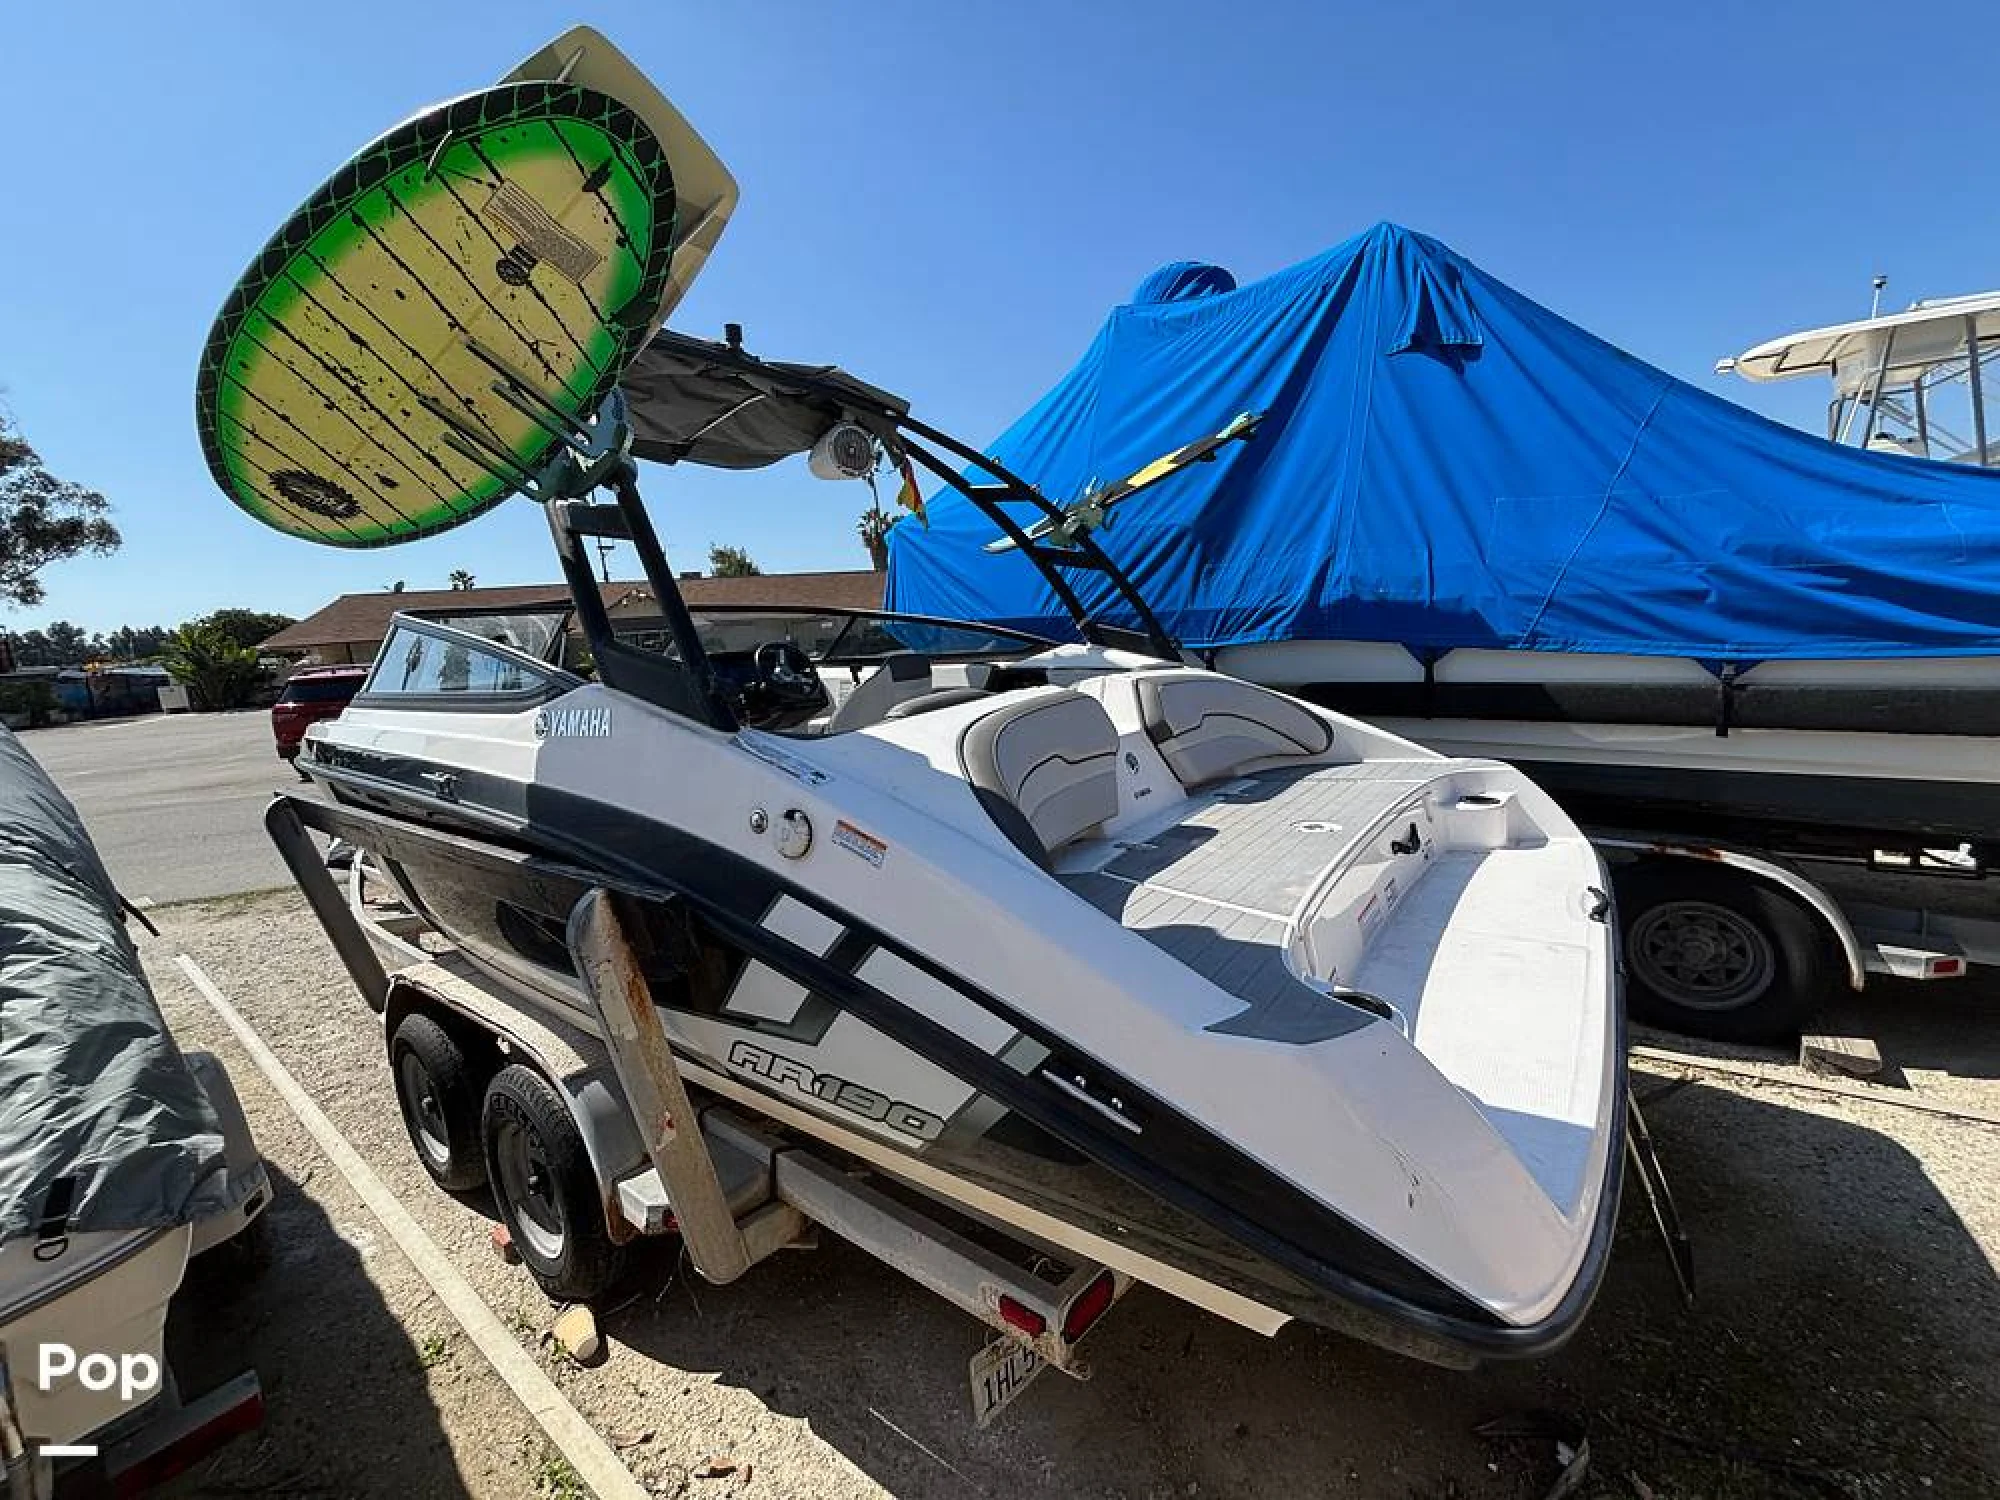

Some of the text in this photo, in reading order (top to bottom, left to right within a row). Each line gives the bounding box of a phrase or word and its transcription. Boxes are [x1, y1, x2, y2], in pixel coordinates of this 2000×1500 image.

[550, 709, 611, 737] YAMAHA
[728, 1040, 946, 1141] AR190
[983, 1346, 1043, 1414] 1HL5
